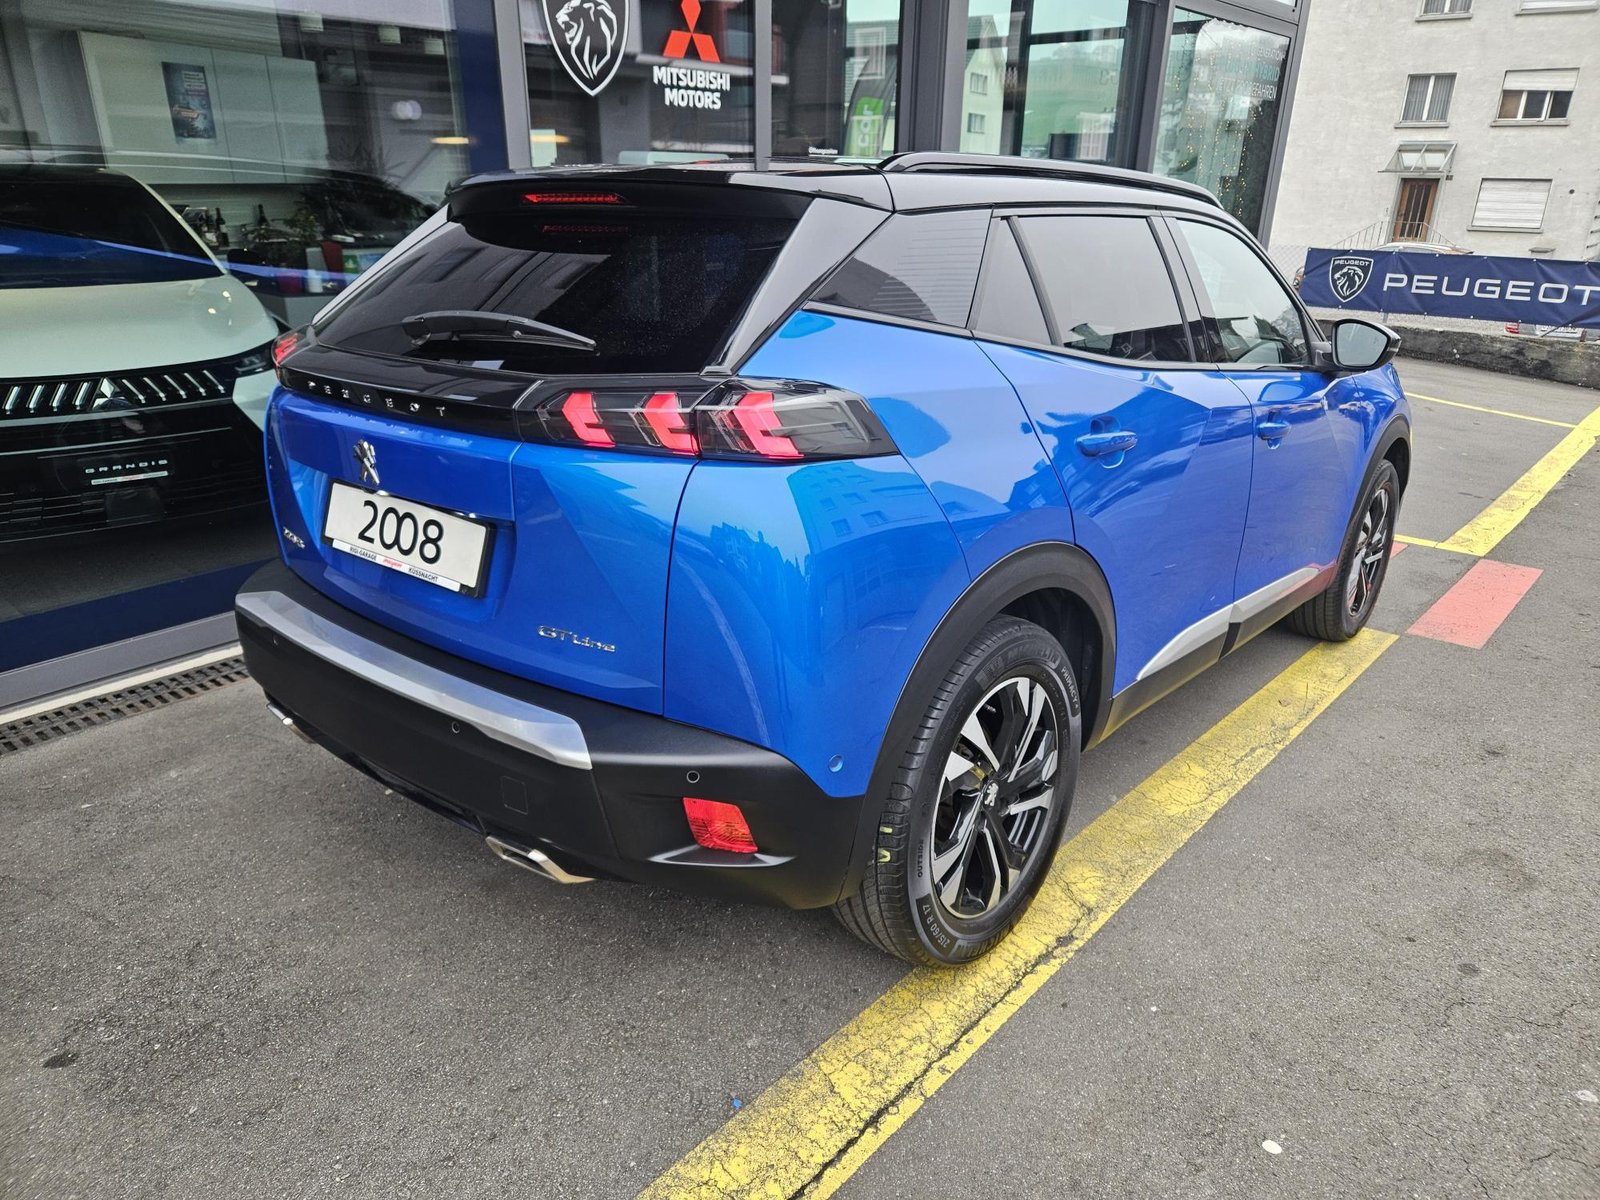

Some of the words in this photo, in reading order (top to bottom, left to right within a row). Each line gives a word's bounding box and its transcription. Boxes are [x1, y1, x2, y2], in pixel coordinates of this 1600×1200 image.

[652, 65, 731, 91] MITSUBISHI
[664, 87, 722, 110] MOTORS
[1334, 259, 1370, 267] PEUGEOT
[1382, 273, 1600, 306] PEUGEOT
[307, 381, 446, 417] PEUGEOT
[85, 459, 168, 474] GRANDIS
[358, 501, 444, 564] 2008
[538, 626, 572, 641] GT
[573, 634, 616, 652] Line
[930, 924, 951, 949] 215/60
